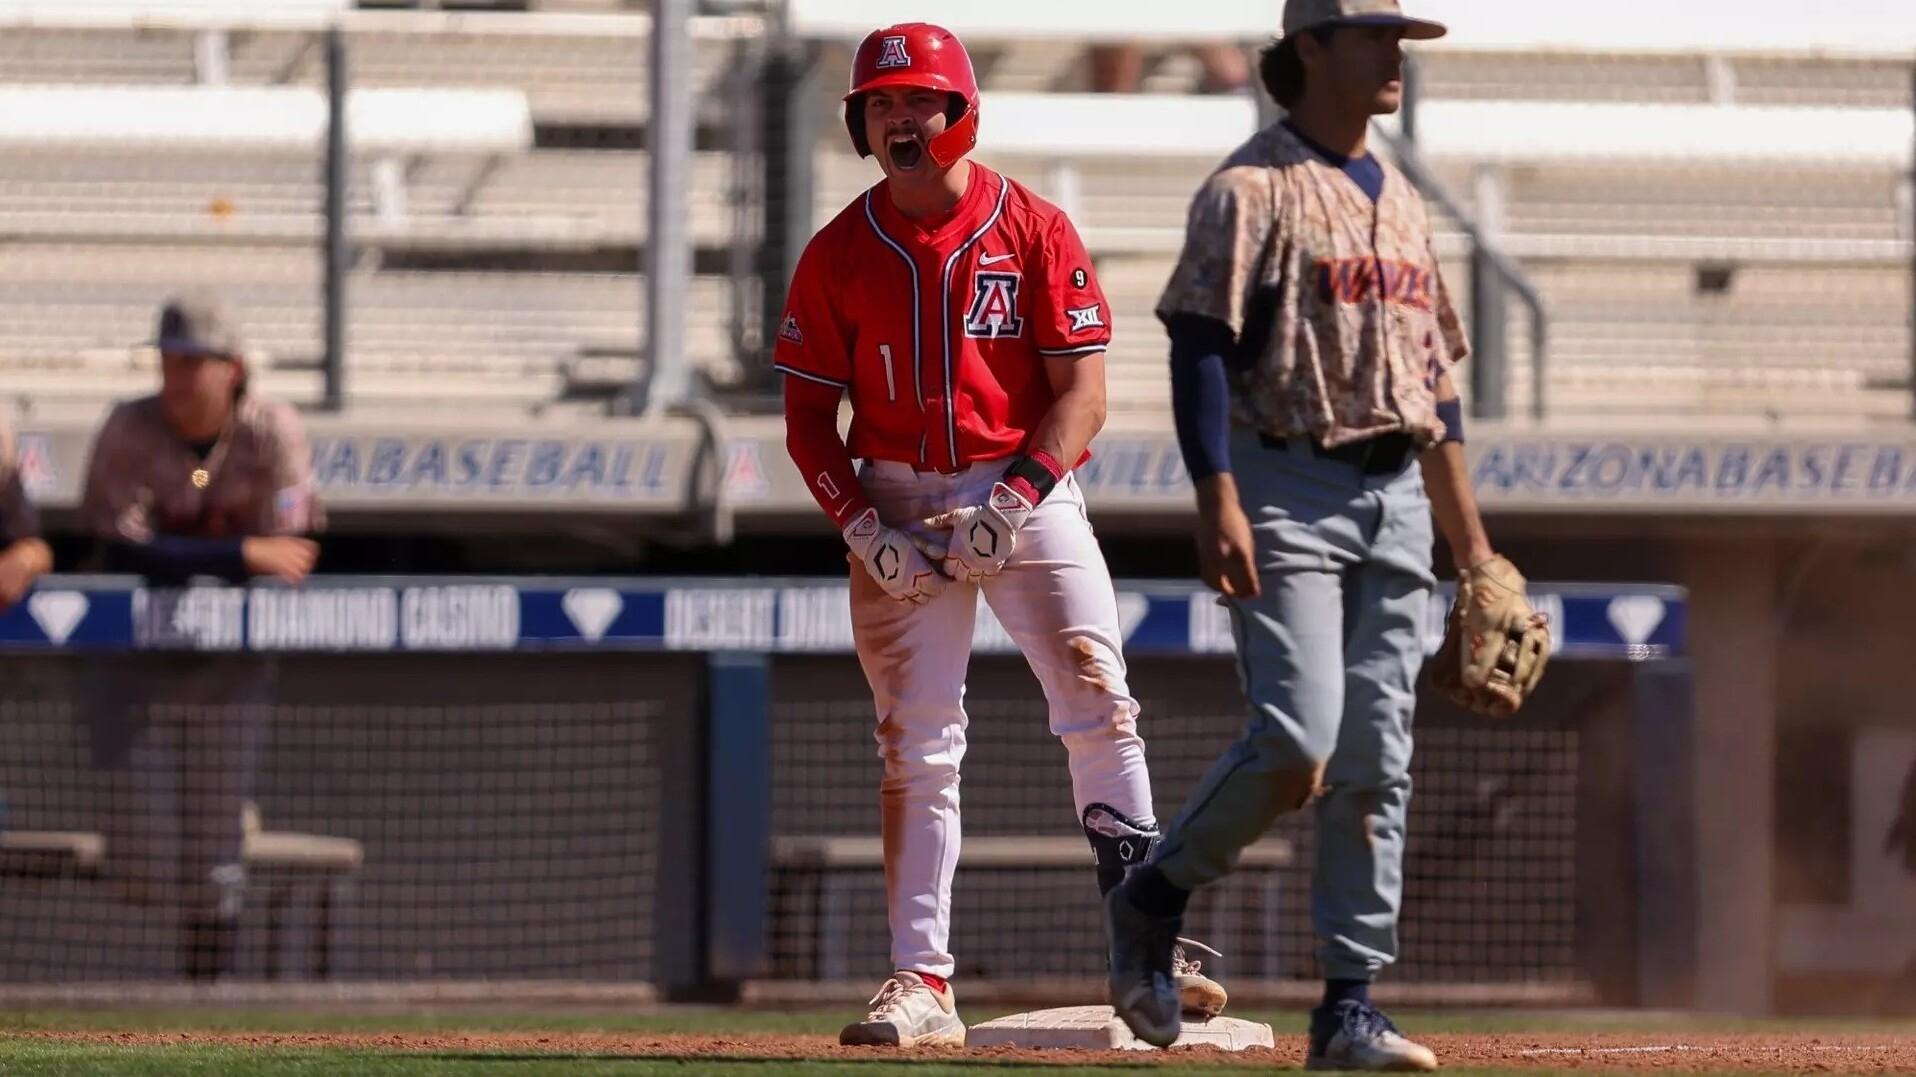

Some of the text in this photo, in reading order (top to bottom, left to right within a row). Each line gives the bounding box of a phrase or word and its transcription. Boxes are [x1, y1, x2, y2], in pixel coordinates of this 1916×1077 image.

[876, 36, 911, 68] A
[1075, 270, 1085, 287] 9
[963, 271, 1024, 339] A
[1067, 305, 1104, 332] XII
[879, 345, 895, 400] 1
[817, 471, 840, 500] 1
